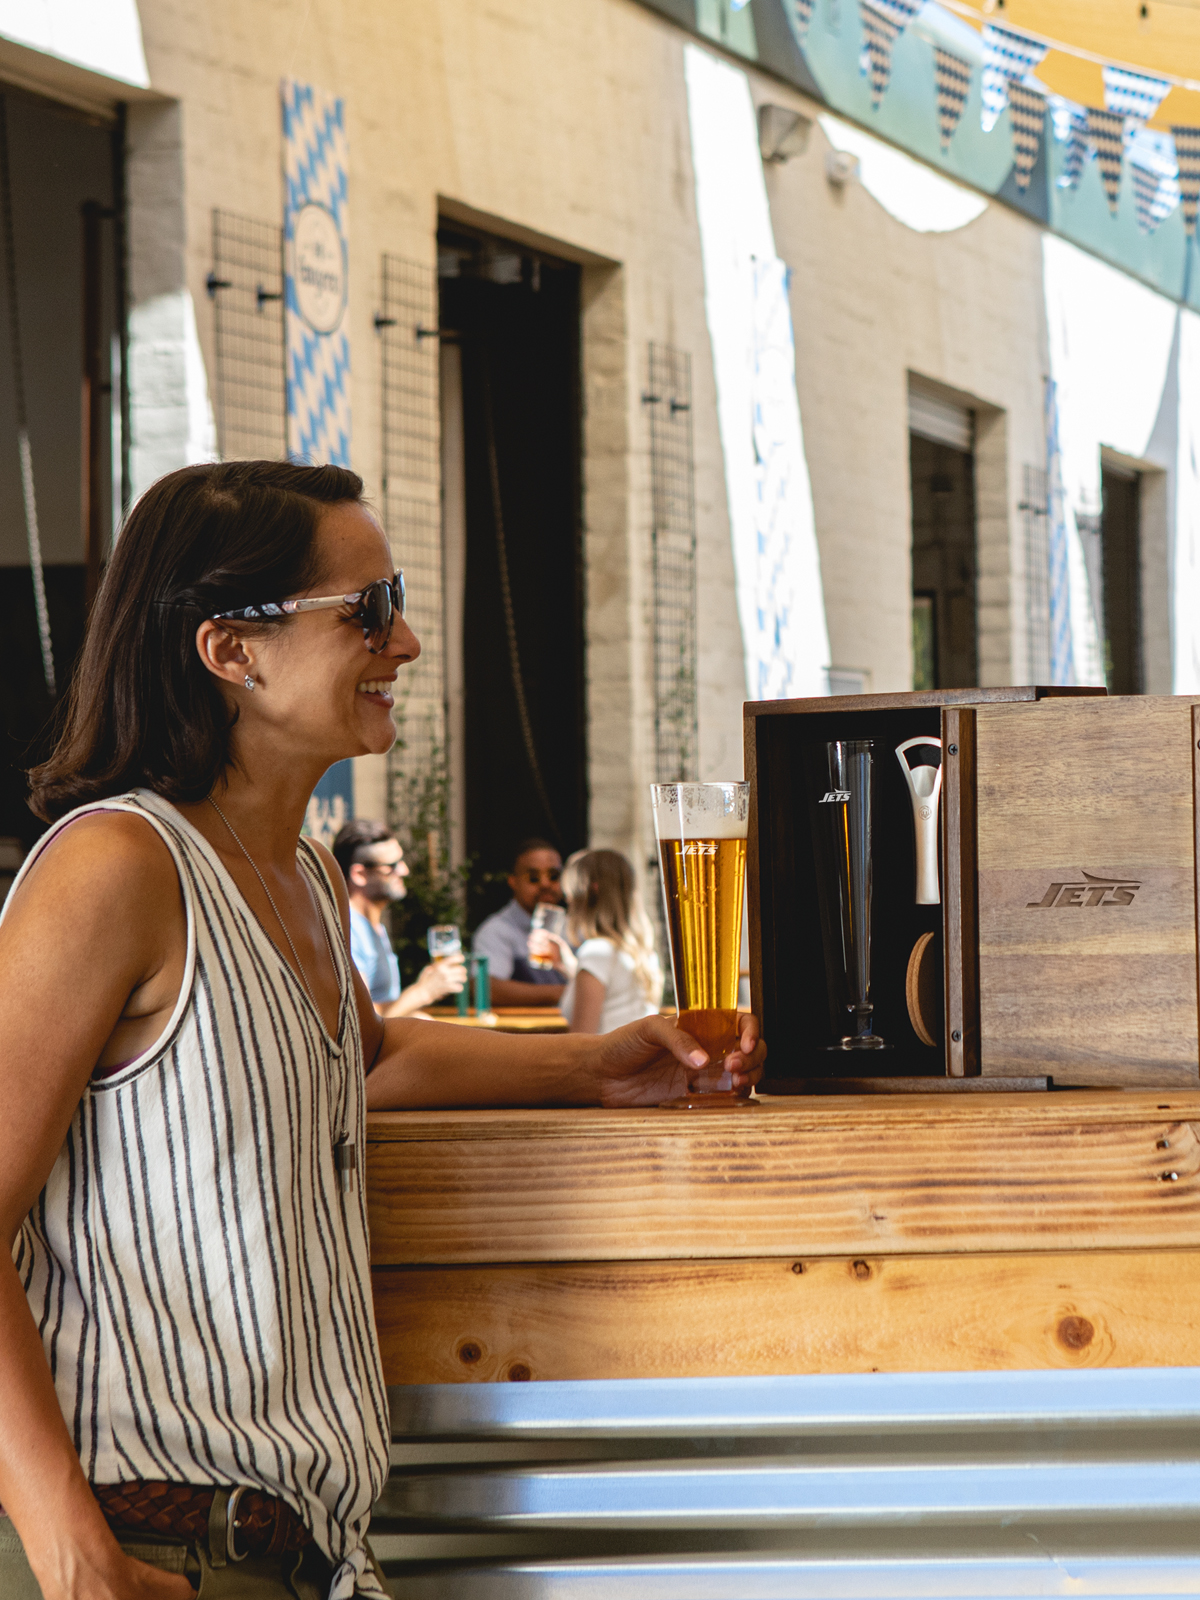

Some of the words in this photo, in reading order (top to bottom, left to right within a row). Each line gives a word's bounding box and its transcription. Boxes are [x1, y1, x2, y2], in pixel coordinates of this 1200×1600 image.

[818, 789, 852, 803] JETS
[675, 842, 718, 855] JETS
[1025, 874, 1142, 908] JETS
